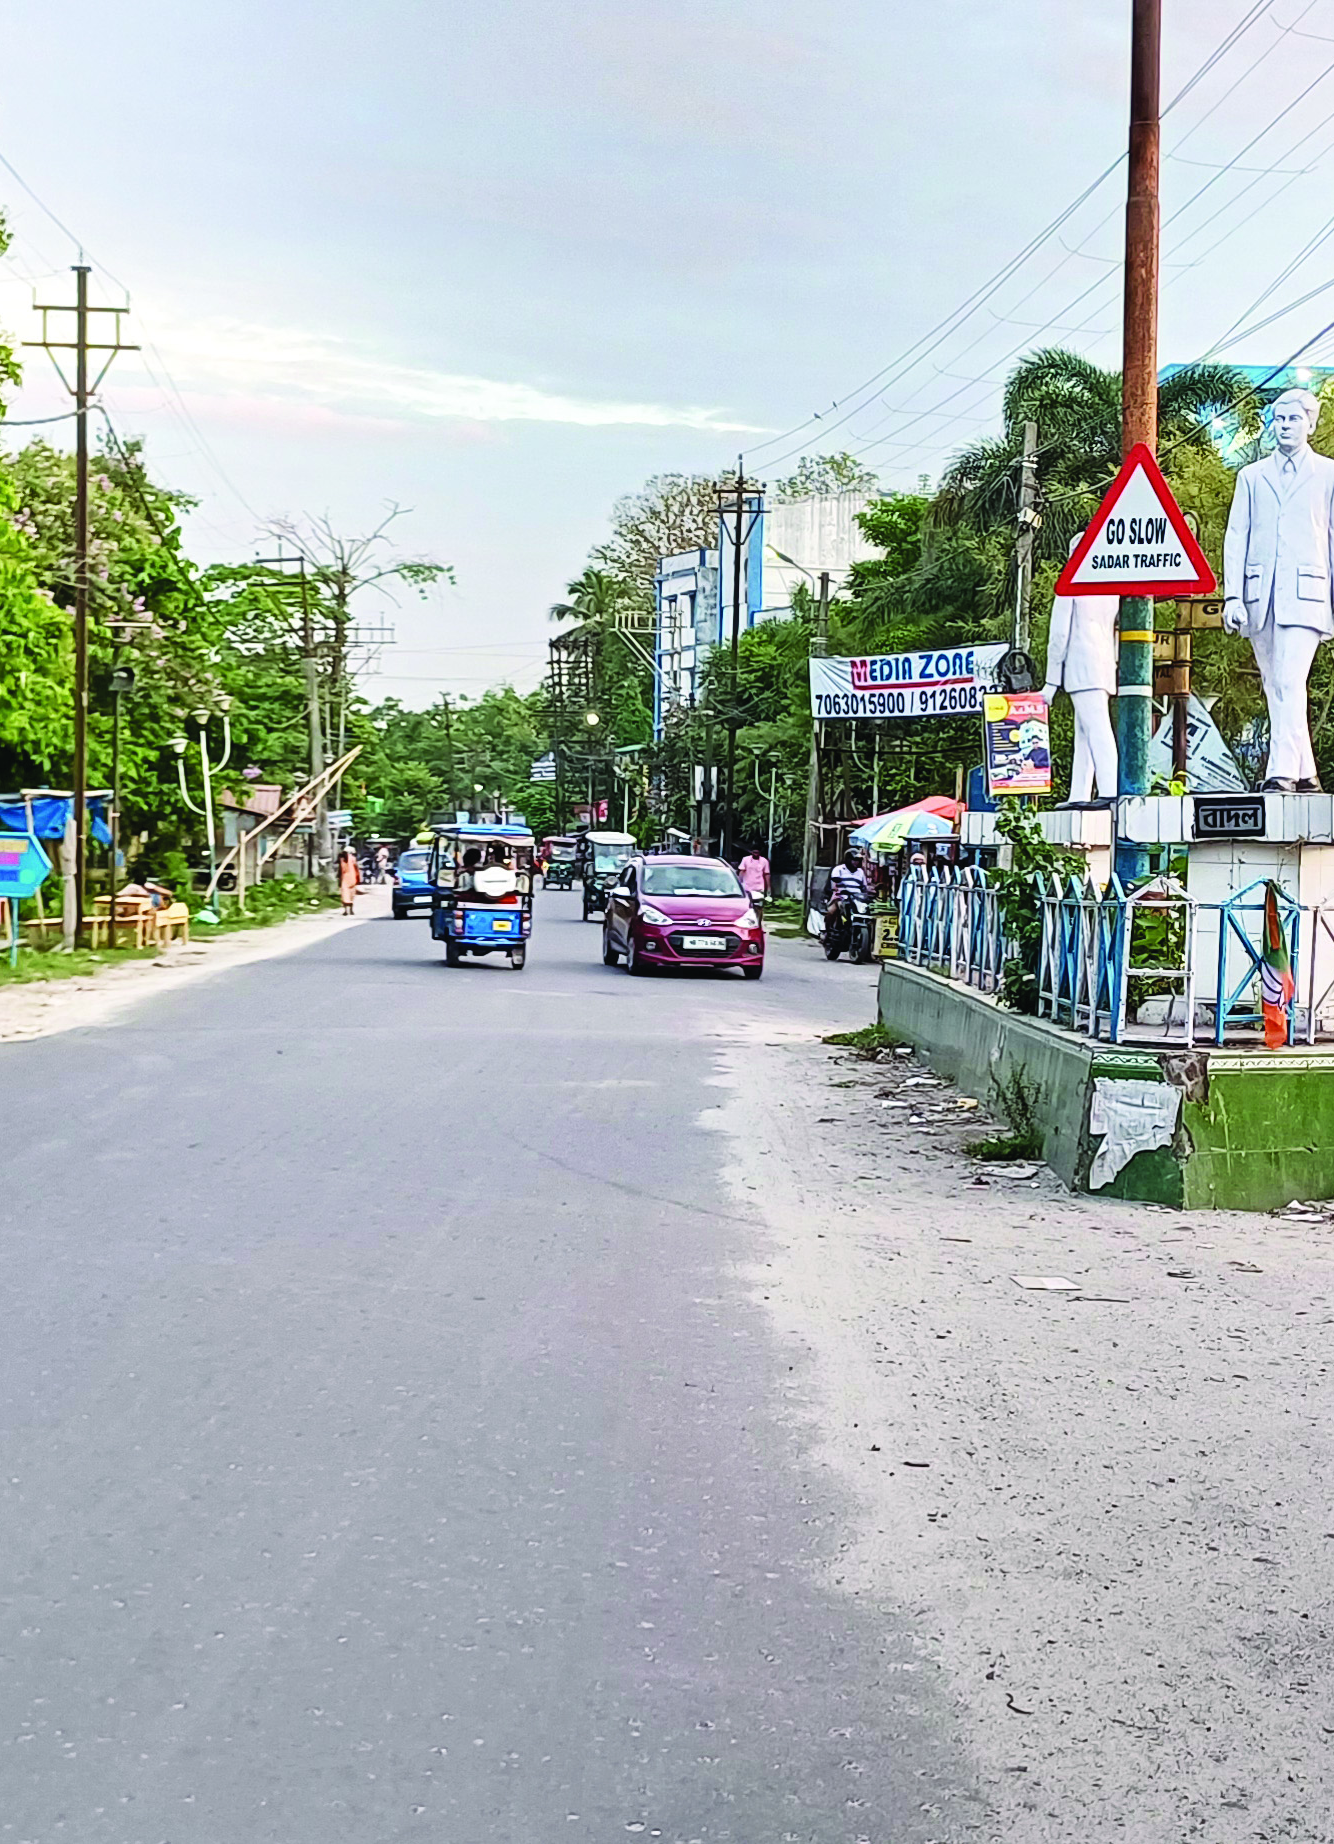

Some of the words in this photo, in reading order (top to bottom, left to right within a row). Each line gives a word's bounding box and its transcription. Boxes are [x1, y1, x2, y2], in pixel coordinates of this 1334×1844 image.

[1107, 518, 1125, 545] GO
[1129, 518, 1167, 544] SLOW
[1092, 555, 1130, 569] SADAR
[1133, 553, 1181, 568] TRAFFIC
[850, 655, 912, 682] MEDIA
[919, 651, 974, 679] ZONE
[815, 691, 905, 715] 7063015900
[1201, 808, 1260, 829] বাদল
